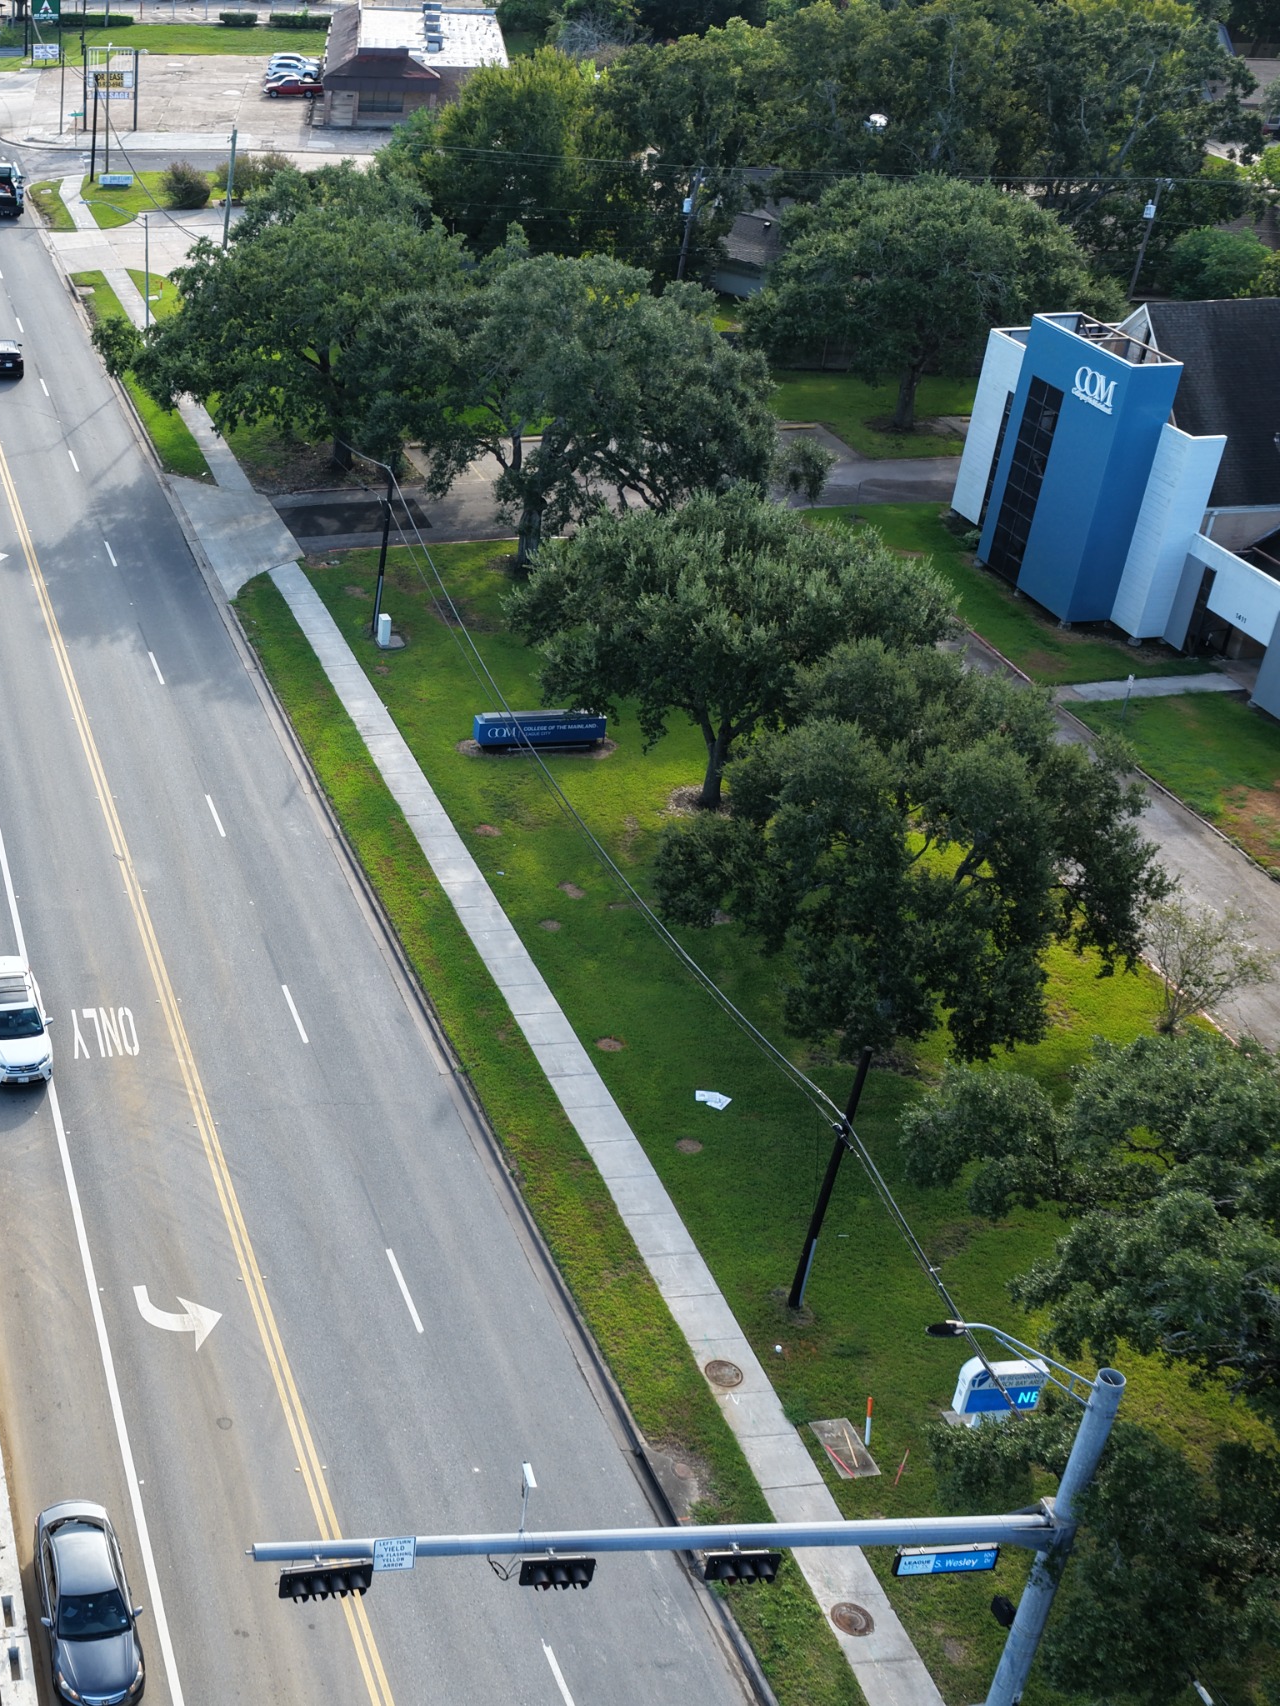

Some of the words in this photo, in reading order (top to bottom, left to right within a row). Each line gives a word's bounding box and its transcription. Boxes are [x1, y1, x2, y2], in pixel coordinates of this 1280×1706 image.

[1075, 366, 1118, 408] COM
[487, 726, 516, 739] COM
[71, 1006, 140, 1060] ONLY
[945, 1558, 978, 1568] Wesley
